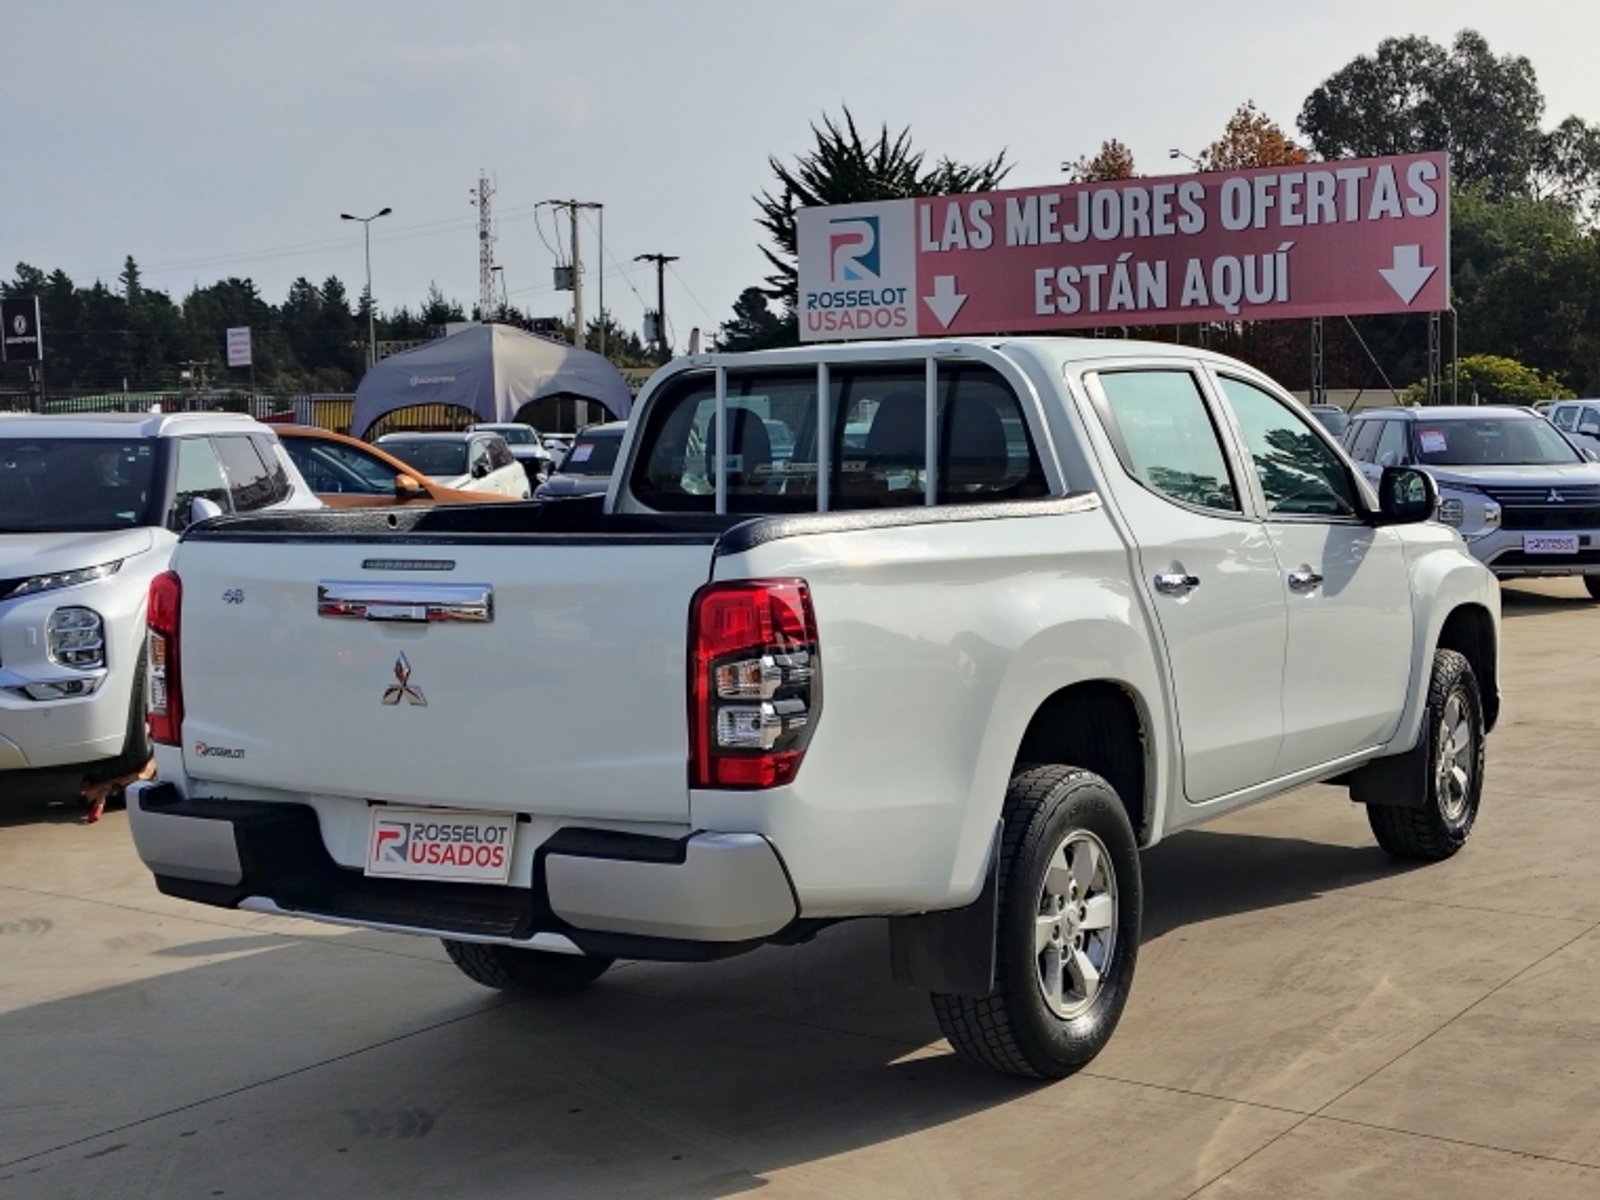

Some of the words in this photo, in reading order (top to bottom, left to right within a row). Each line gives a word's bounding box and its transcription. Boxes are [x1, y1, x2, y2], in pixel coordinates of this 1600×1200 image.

[920, 199, 994, 252] LAS
[1005, 181, 1206, 247] MEJORES
[1220, 159, 1439, 232] OFERTAS
[1034, 251, 1168, 315] ESTÁN
[1180, 240, 1298, 315] AQUÍ
[806, 287, 907, 310] ROSSELOT
[807, 307, 908, 331] USADOS
[412, 823, 508, 844] ROSSELOT
[410, 842, 504, 868] USADOS
